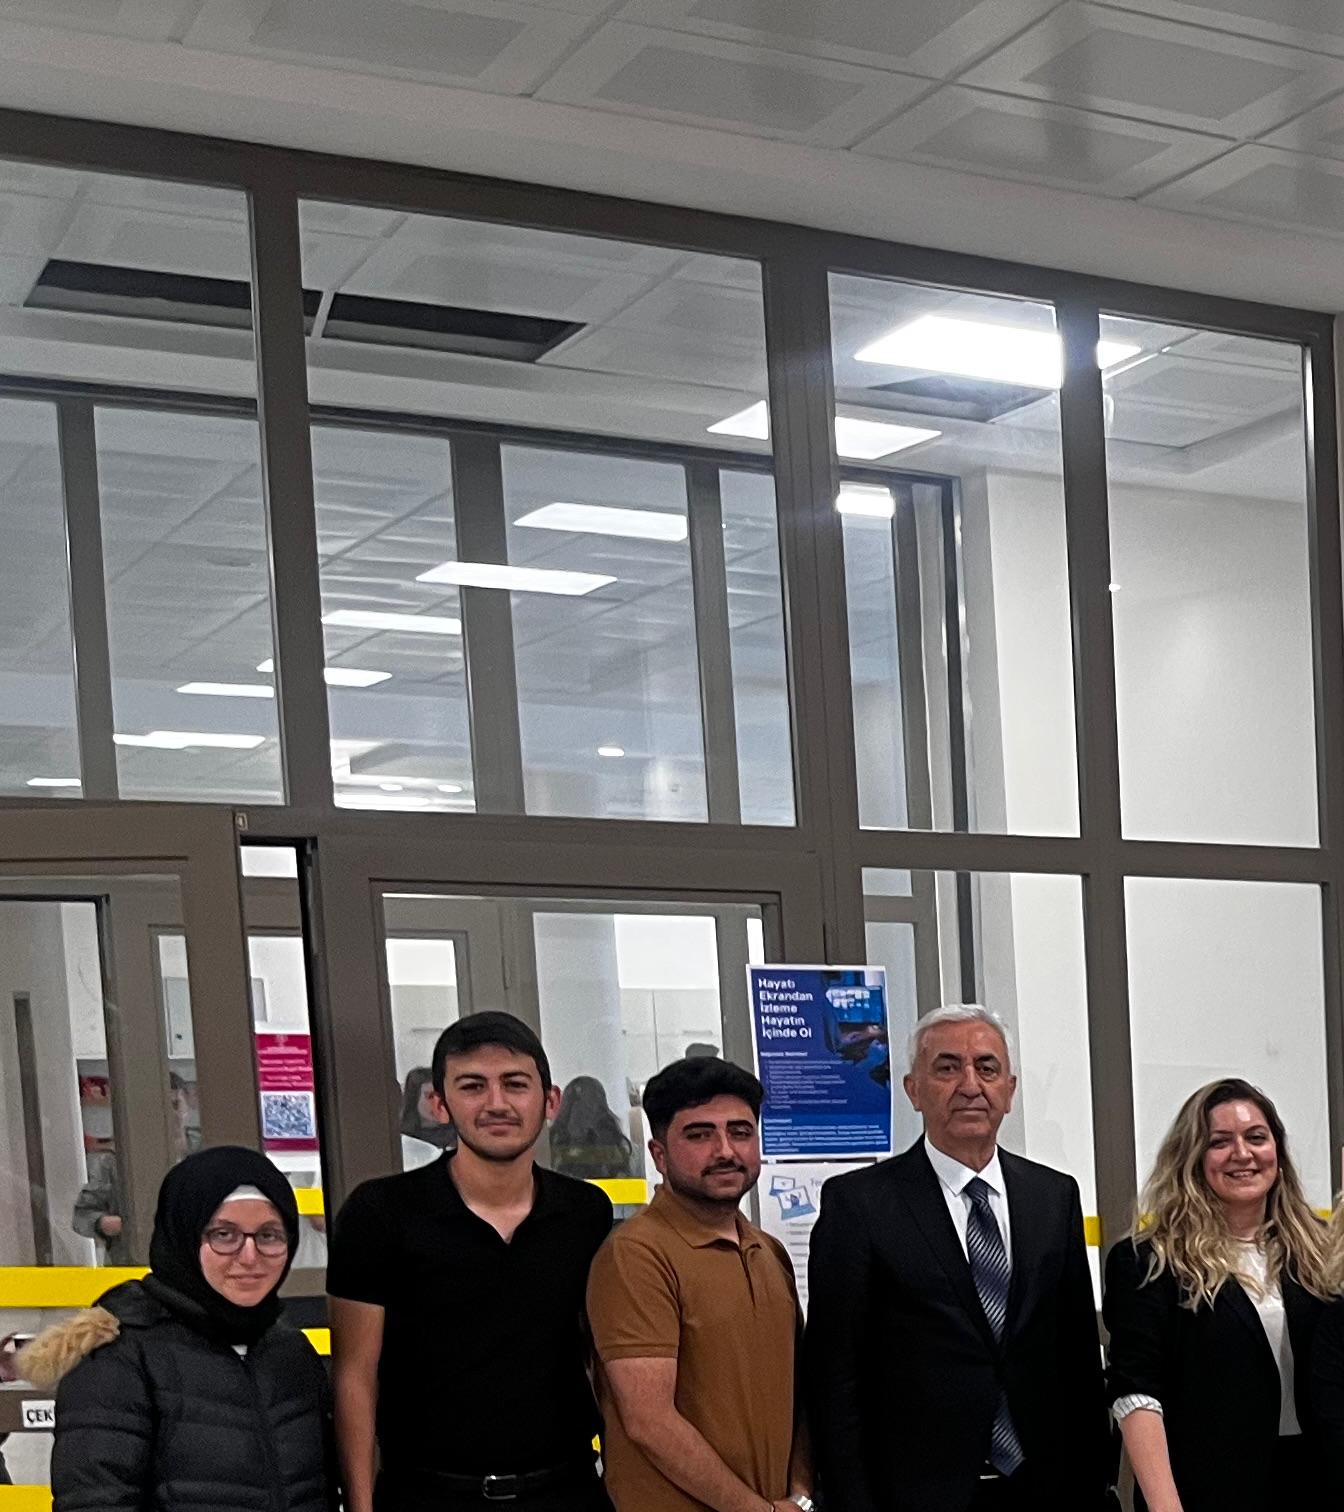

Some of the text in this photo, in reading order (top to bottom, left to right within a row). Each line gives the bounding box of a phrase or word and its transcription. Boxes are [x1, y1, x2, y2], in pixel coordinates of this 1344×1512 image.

[758, 978, 796, 991] Hayatı
[759, 990, 813, 1001] Ekrandan
[760, 1000, 798, 1013] İzleme
[761, 1015, 805, 1028] Hayatın
[799, 1027, 812, 1038] Ol
[26, 1409, 54, 1424] ÇEK
